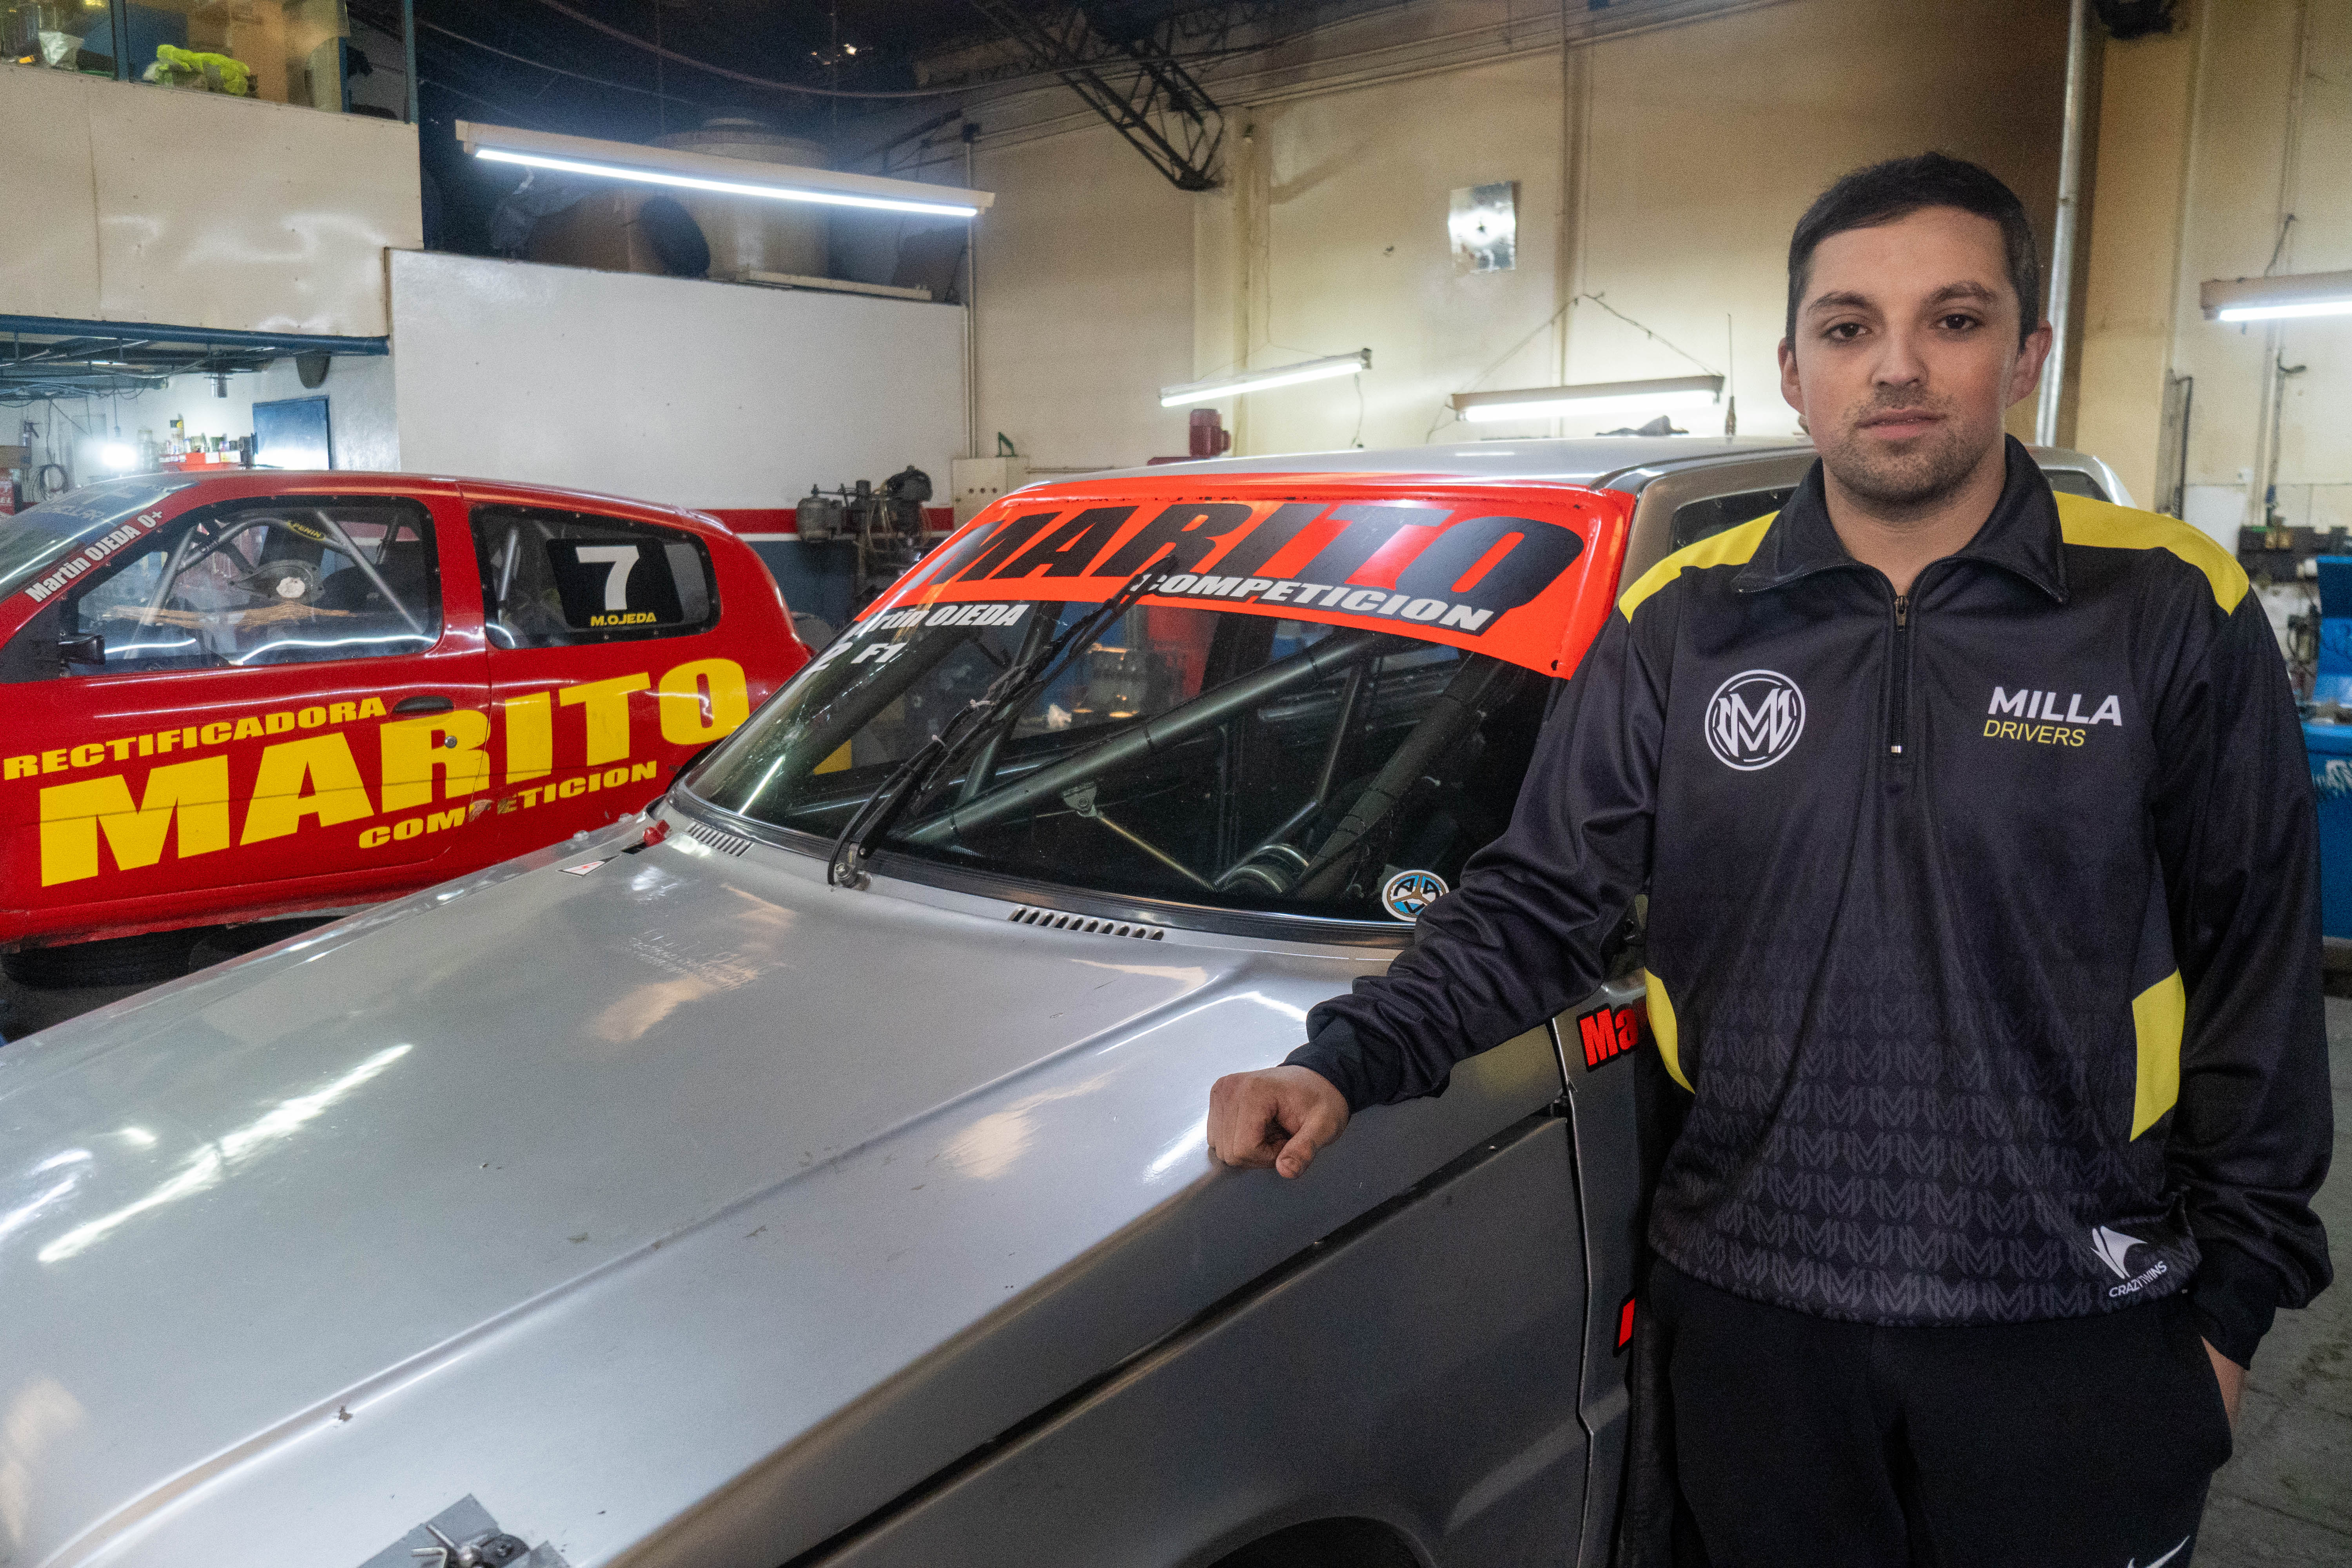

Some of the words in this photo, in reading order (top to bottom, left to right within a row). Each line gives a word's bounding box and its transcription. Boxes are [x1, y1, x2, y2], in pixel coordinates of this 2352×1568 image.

[25, 557, 91, 602] Martin
[84, 524, 142, 561] OJEDA
[575, 545, 640, 611] 7
[906, 503, 1584, 609] MARITO
[590, 612, 657, 626] M.OJEDA
[925, 604, 1030, 626] OJEDA
[850, 643, 907, 664] F1
[4, 697, 387, 780] RECTIFICADORA
[1983, 719, 2086, 747] DRIVERS
[1987, 686, 2122, 726] MILLA
[40, 658, 750, 887] MARITO
[358, 760, 657, 849] COMETICION
